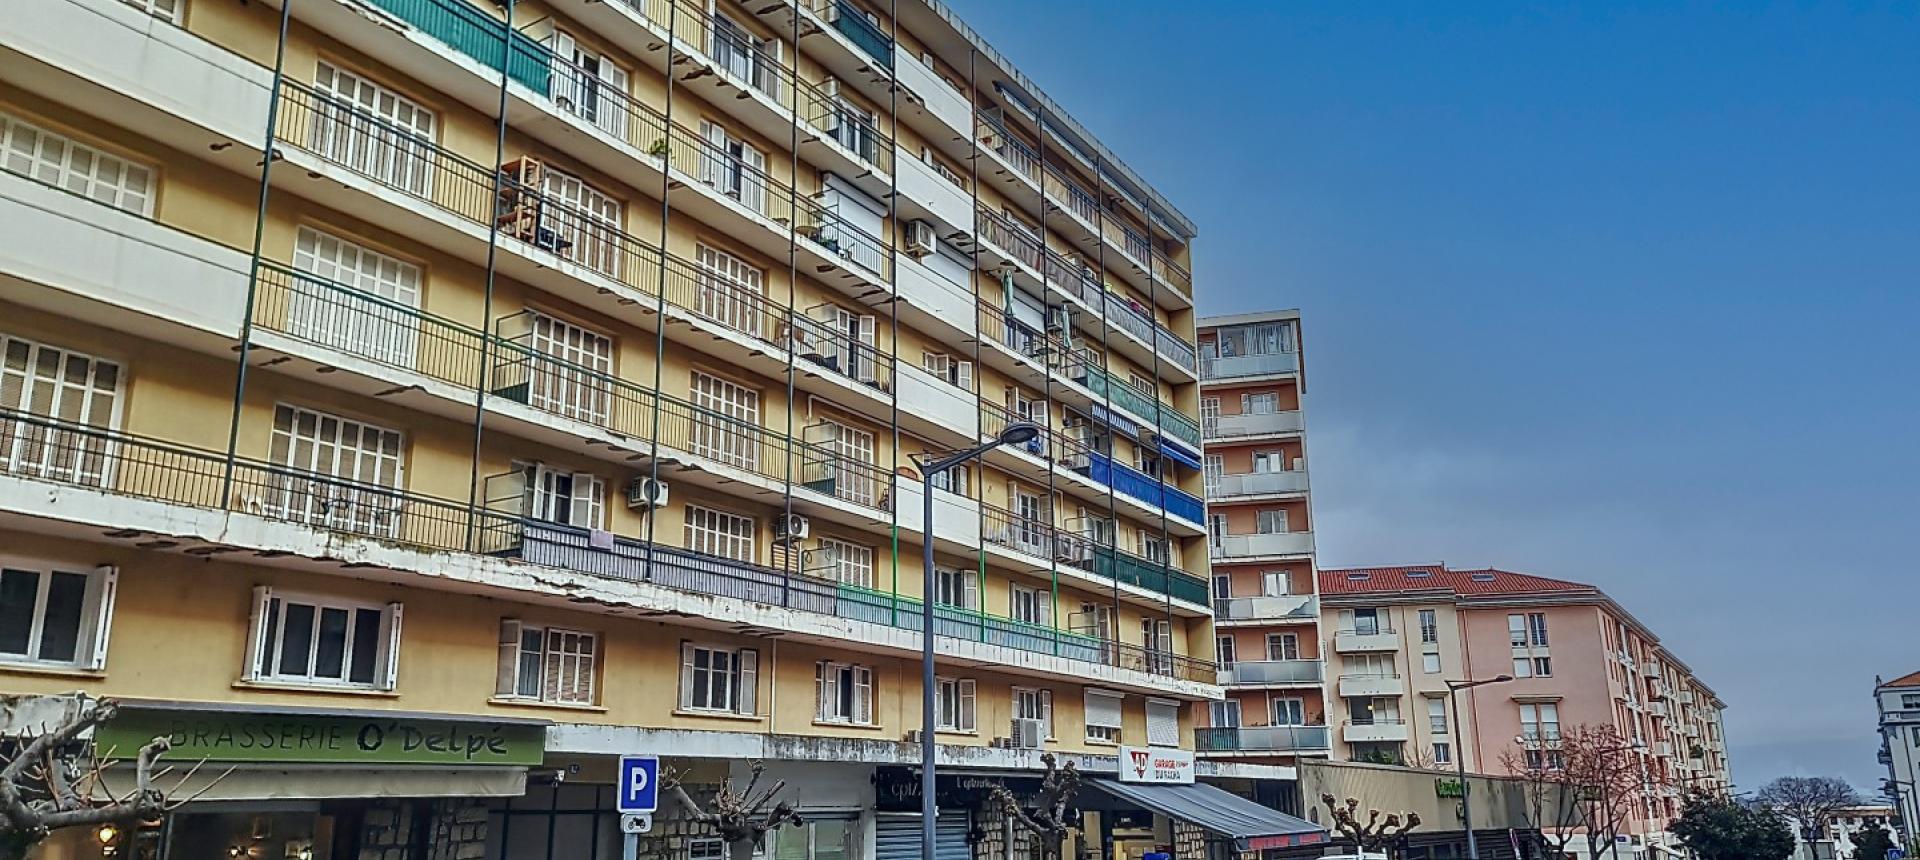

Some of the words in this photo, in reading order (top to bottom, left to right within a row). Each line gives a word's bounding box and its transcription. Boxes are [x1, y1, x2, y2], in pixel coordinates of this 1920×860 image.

[170, 720, 342, 750] BRASSERIE
[357, 721, 508, 760] O'Delpé
[630, 766, 648, 801] P
